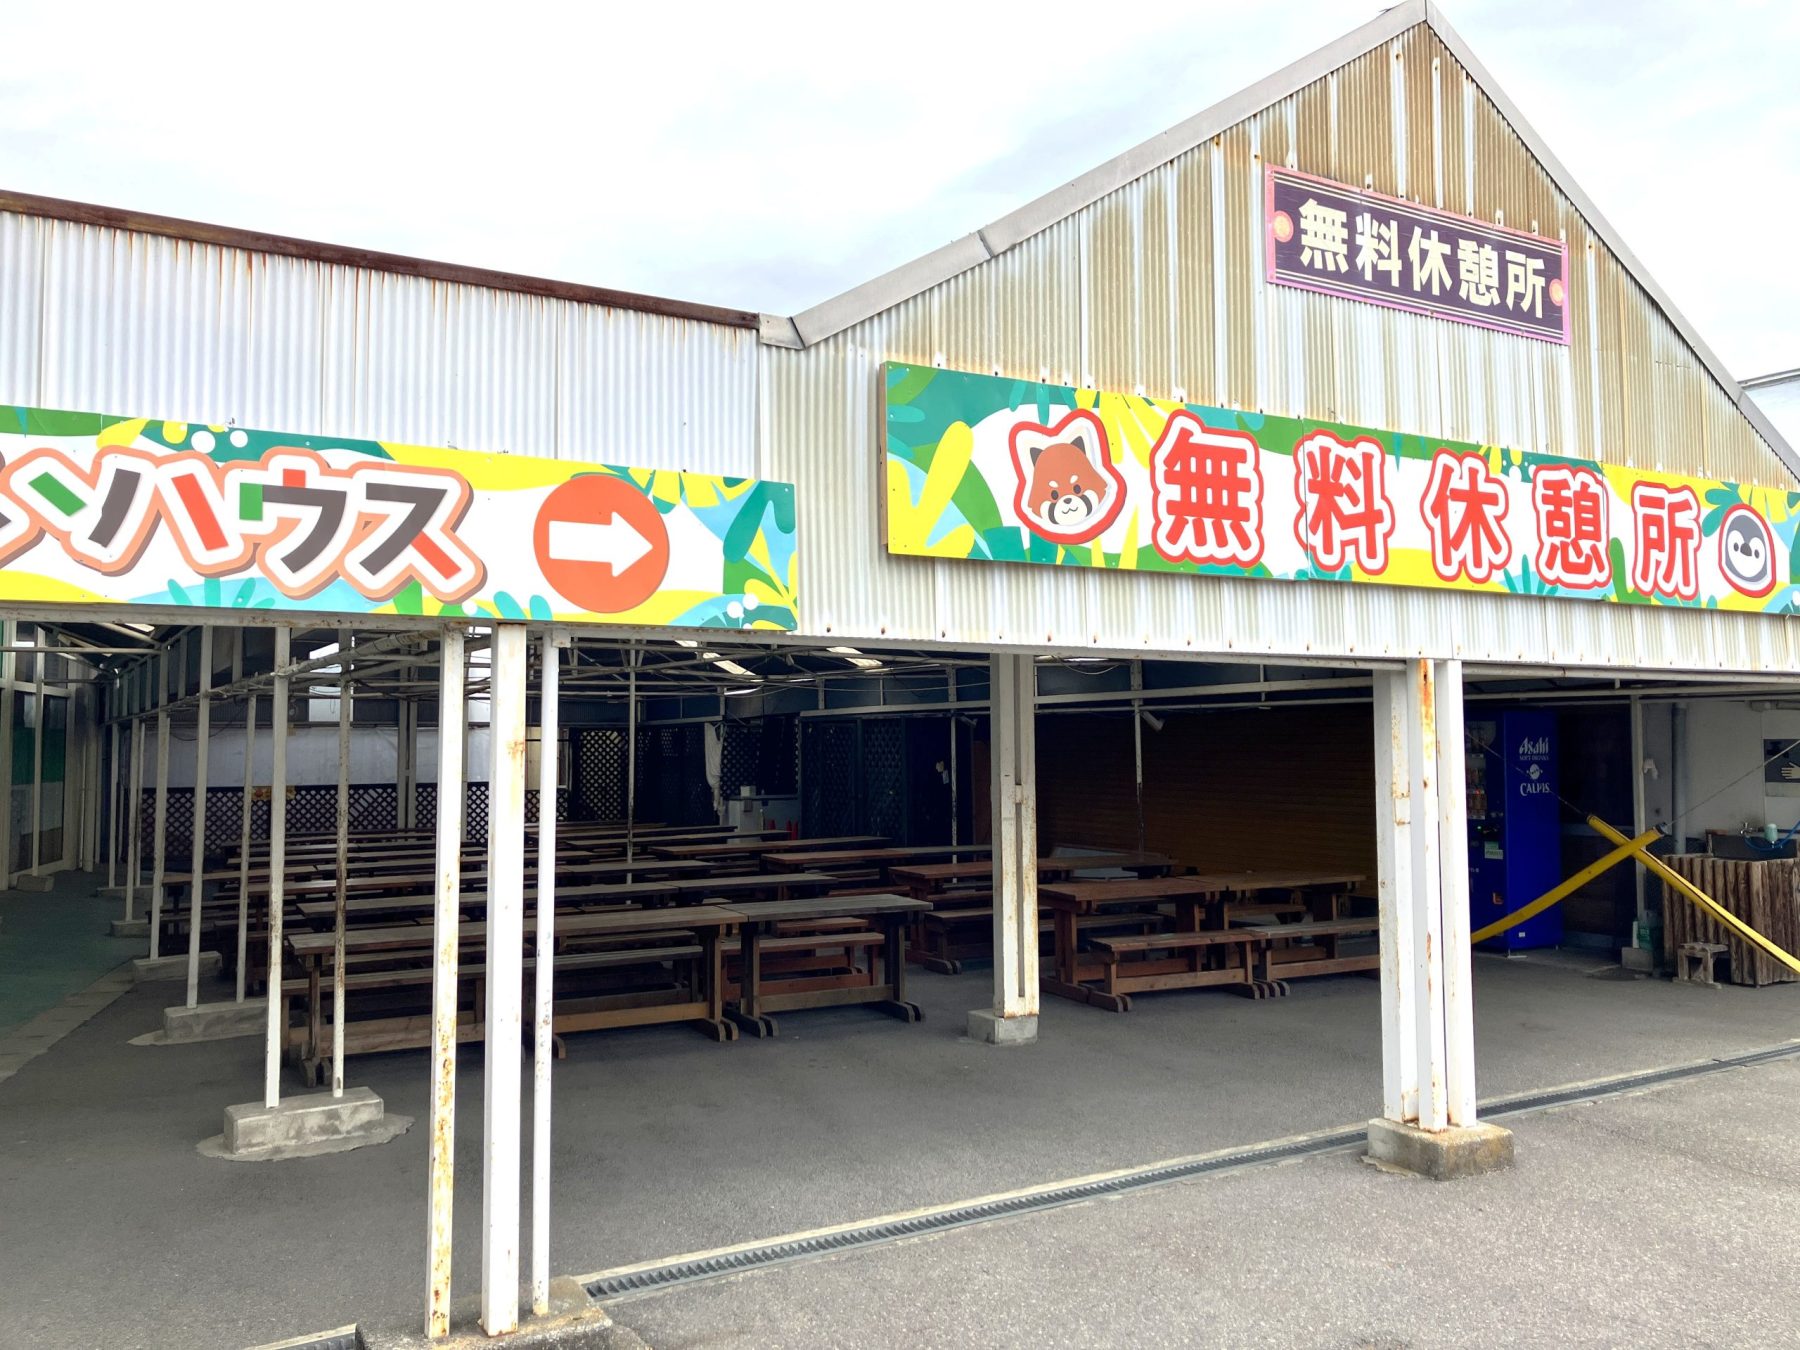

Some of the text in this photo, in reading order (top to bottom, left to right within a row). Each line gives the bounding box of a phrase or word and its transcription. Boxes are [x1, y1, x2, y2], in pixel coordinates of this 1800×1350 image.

[1299, 198, 1546, 318] 無料休憩所
[1158, 422, 1698, 594] 無料休憩所
[1519, 736, 1549, 754] Asahi
[1520, 781, 1550, 797] CALPIS
